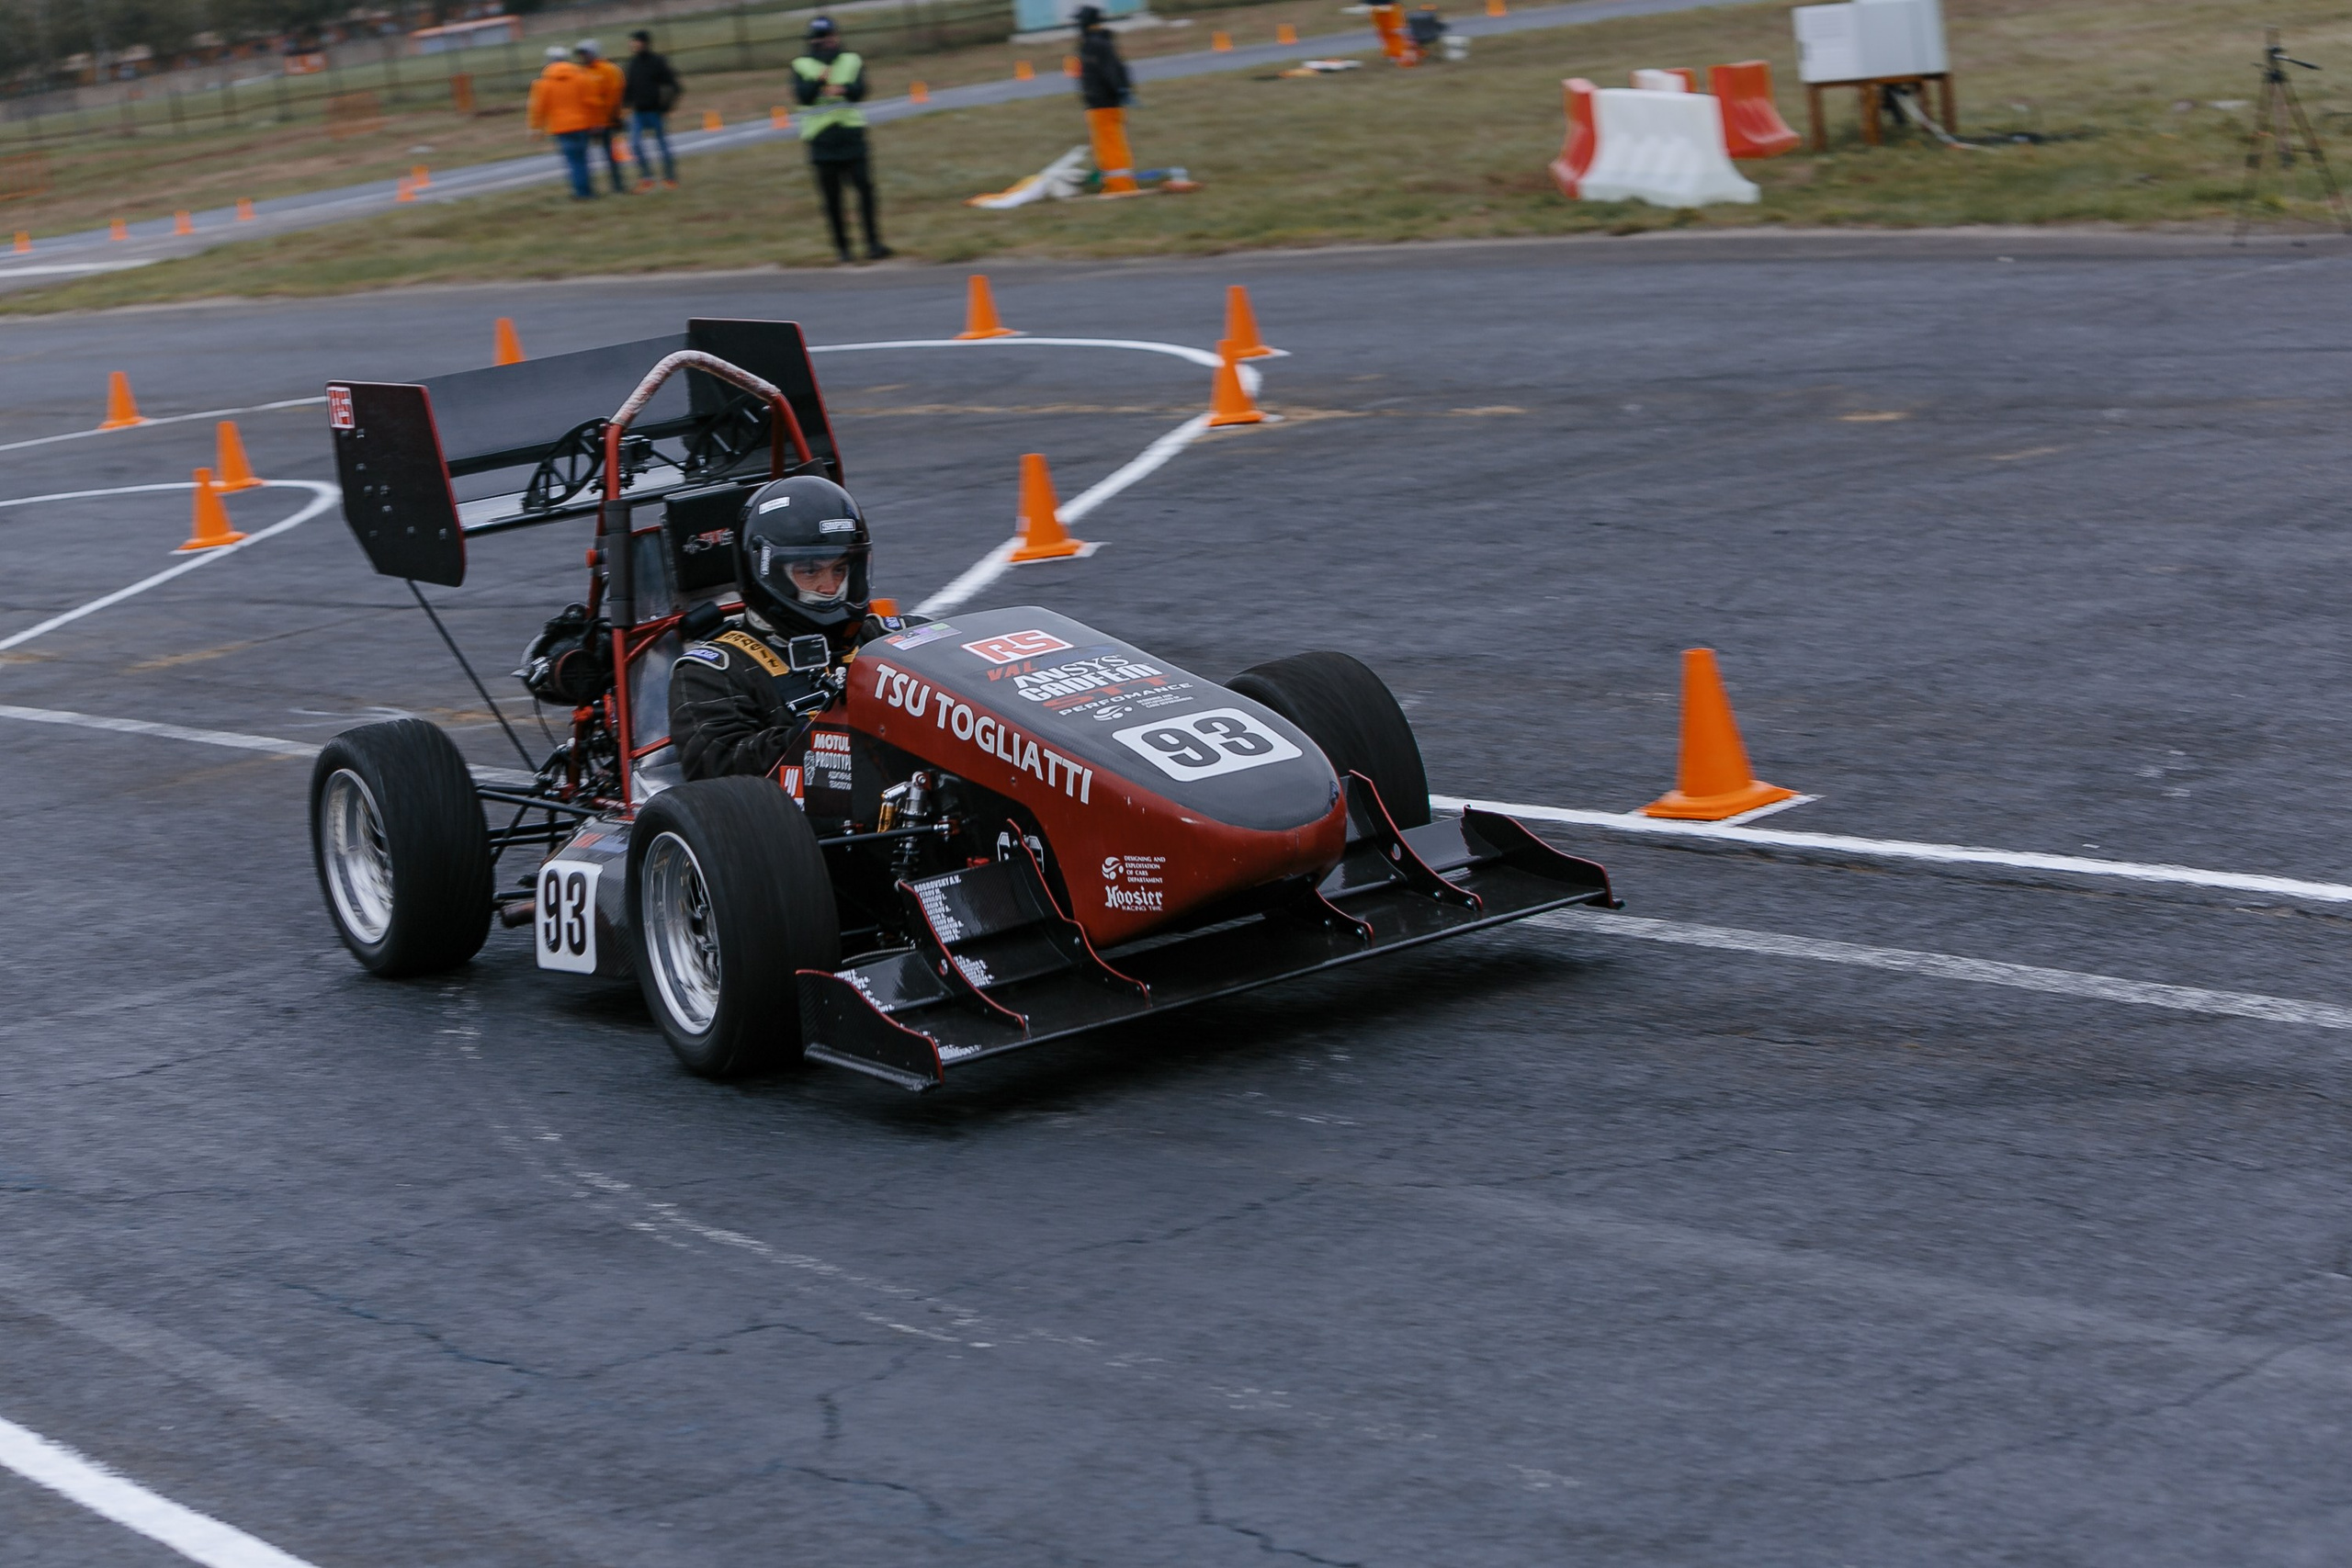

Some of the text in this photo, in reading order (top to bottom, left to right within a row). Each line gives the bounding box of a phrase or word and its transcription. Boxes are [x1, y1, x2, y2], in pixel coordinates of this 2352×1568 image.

[967, 630, 1068, 661] RS
[1012, 654, 1130, 689] ANSYS
[1017, 663, 1163, 702] CADFEM
[1058, 682, 1193, 716] PERFOMANCE
[813, 733, 851, 751] MOTUL
[875, 663, 1093, 805] TSU TOGLIATTI
[1141, 716, 1274, 768] 93
[544, 868, 587, 956] 93
[1104, 885, 1163, 908] Hoosier
